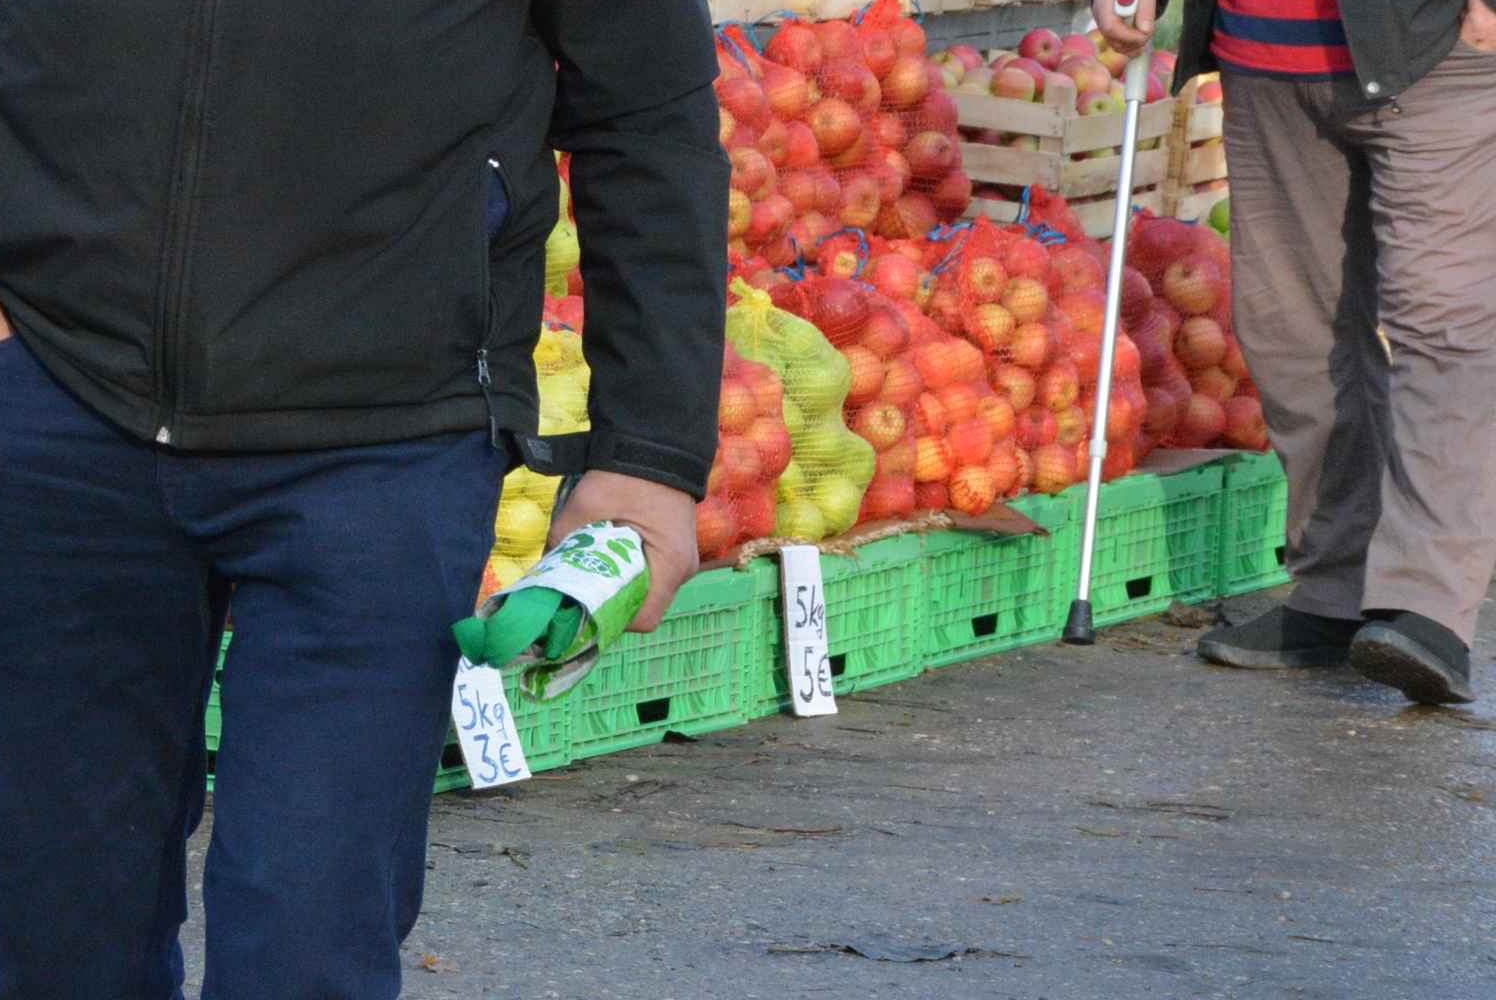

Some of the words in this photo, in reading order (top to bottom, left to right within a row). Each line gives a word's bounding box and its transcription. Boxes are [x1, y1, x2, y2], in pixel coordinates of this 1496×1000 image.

[795, 585, 825, 640] 5kg
[800, 646, 832, 703] 5€
[457, 684, 508, 740] 5kg
[473, 733, 522, 783] 3€
